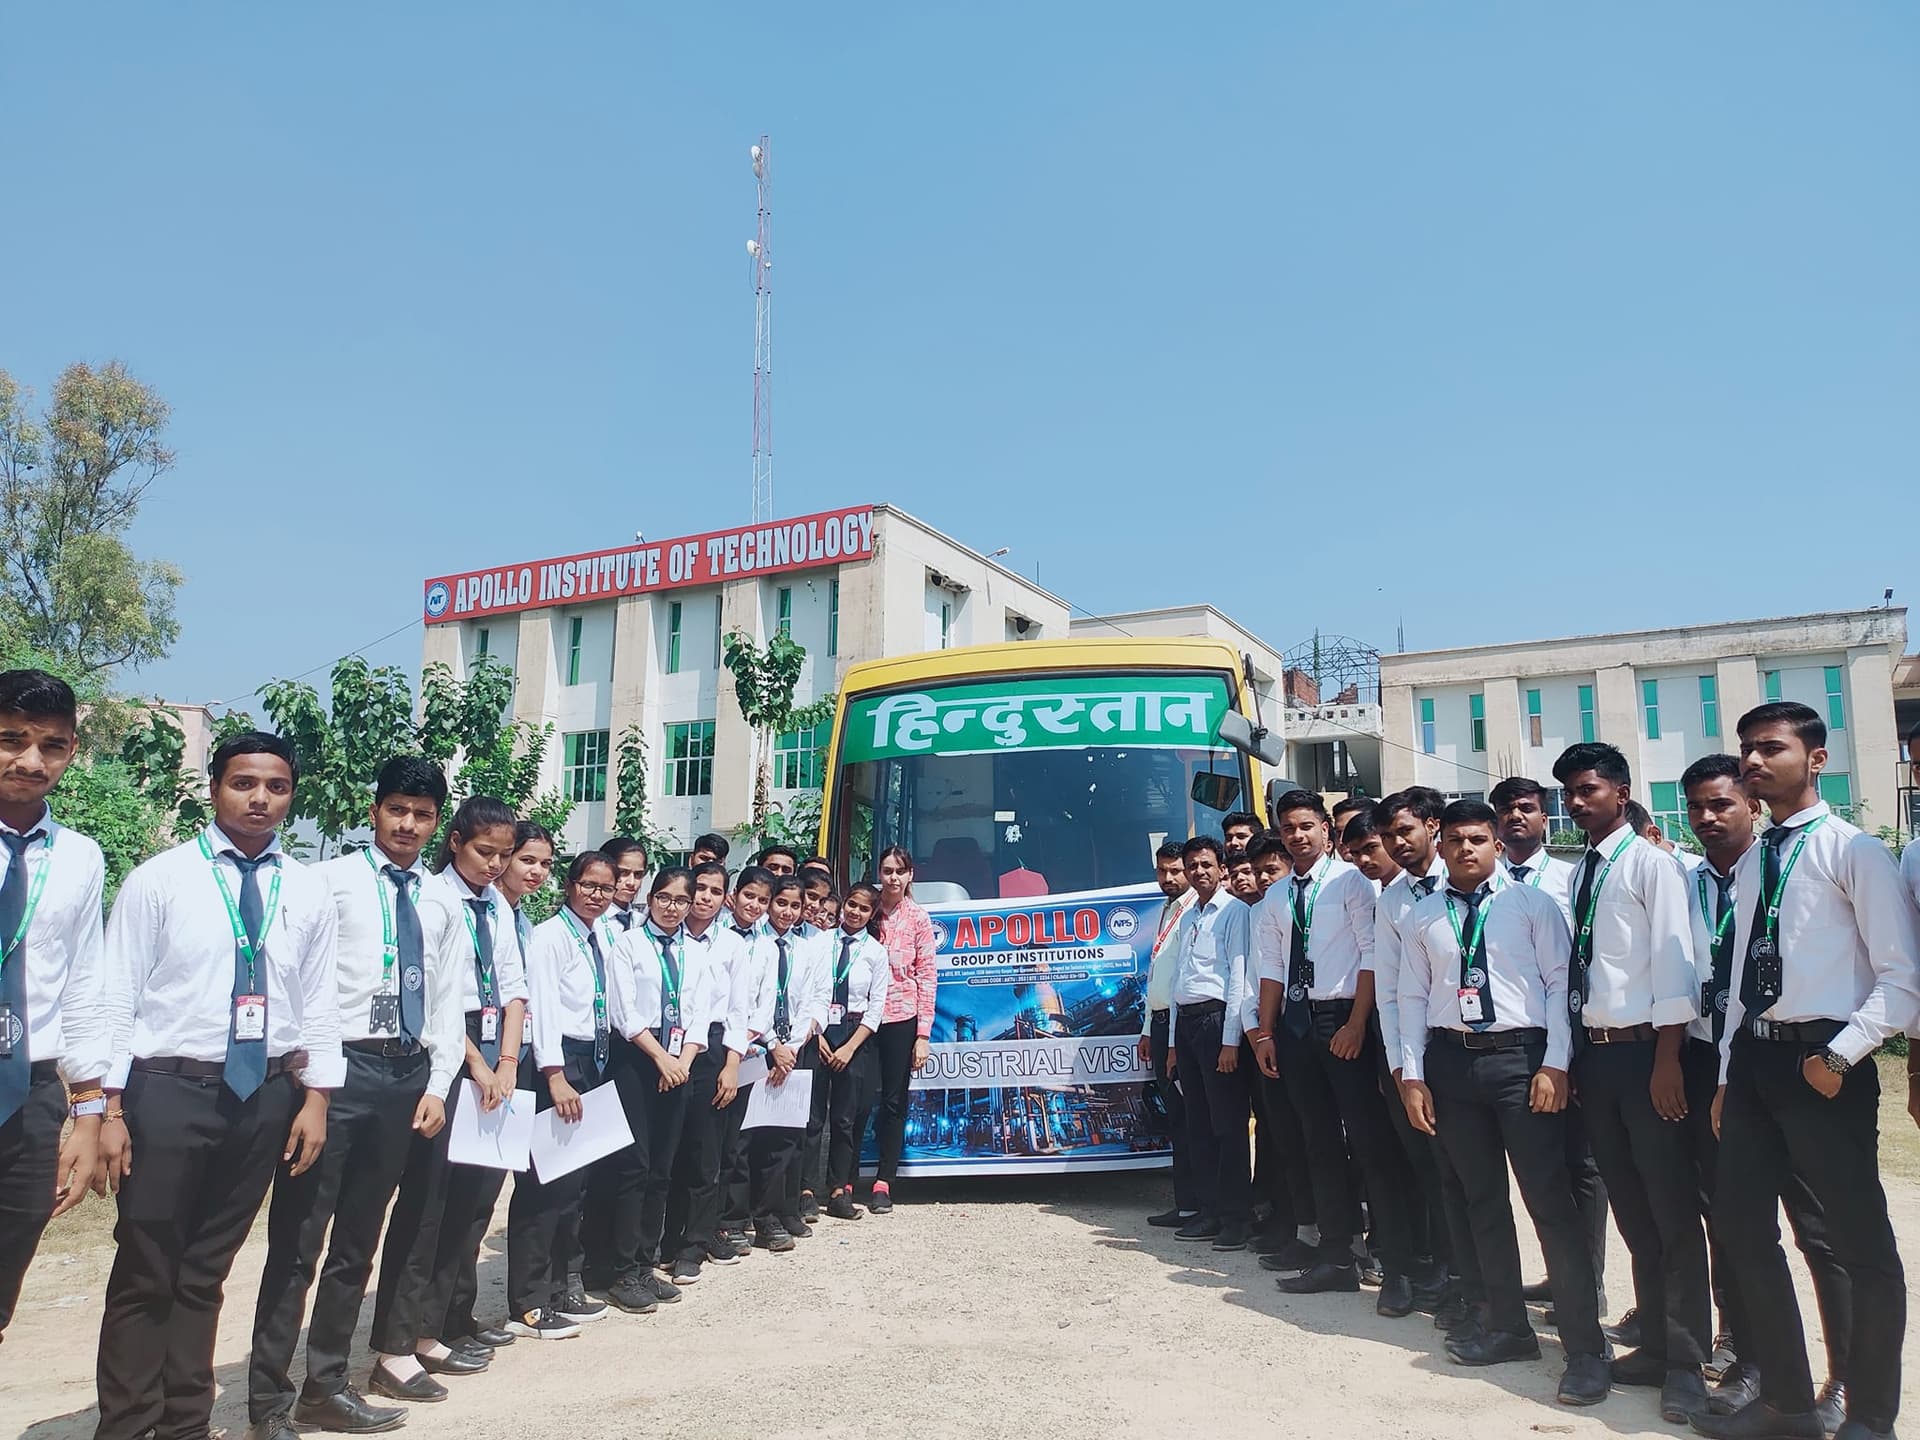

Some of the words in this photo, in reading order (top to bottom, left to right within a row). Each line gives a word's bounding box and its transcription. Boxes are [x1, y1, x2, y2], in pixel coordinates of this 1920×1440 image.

[454, 568, 531, 613] APOLLO
[538, 548, 661, 600] INSTITUTE
[668, 542, 699, 583] OF
[706, 511, 874, 576] TECHNOLOGY
[865, 692, 1214, 751] हिन्दुस्तान
[953, 908, 1101, 949] APOLLO
[951, 953, 996, 966] GROUP
[997, 952, 1013, 964] OF
[1016, 948, 1104, 963] INSTITUTIONS
[911, 1049, 1074, 1079] DUSTRIAL
